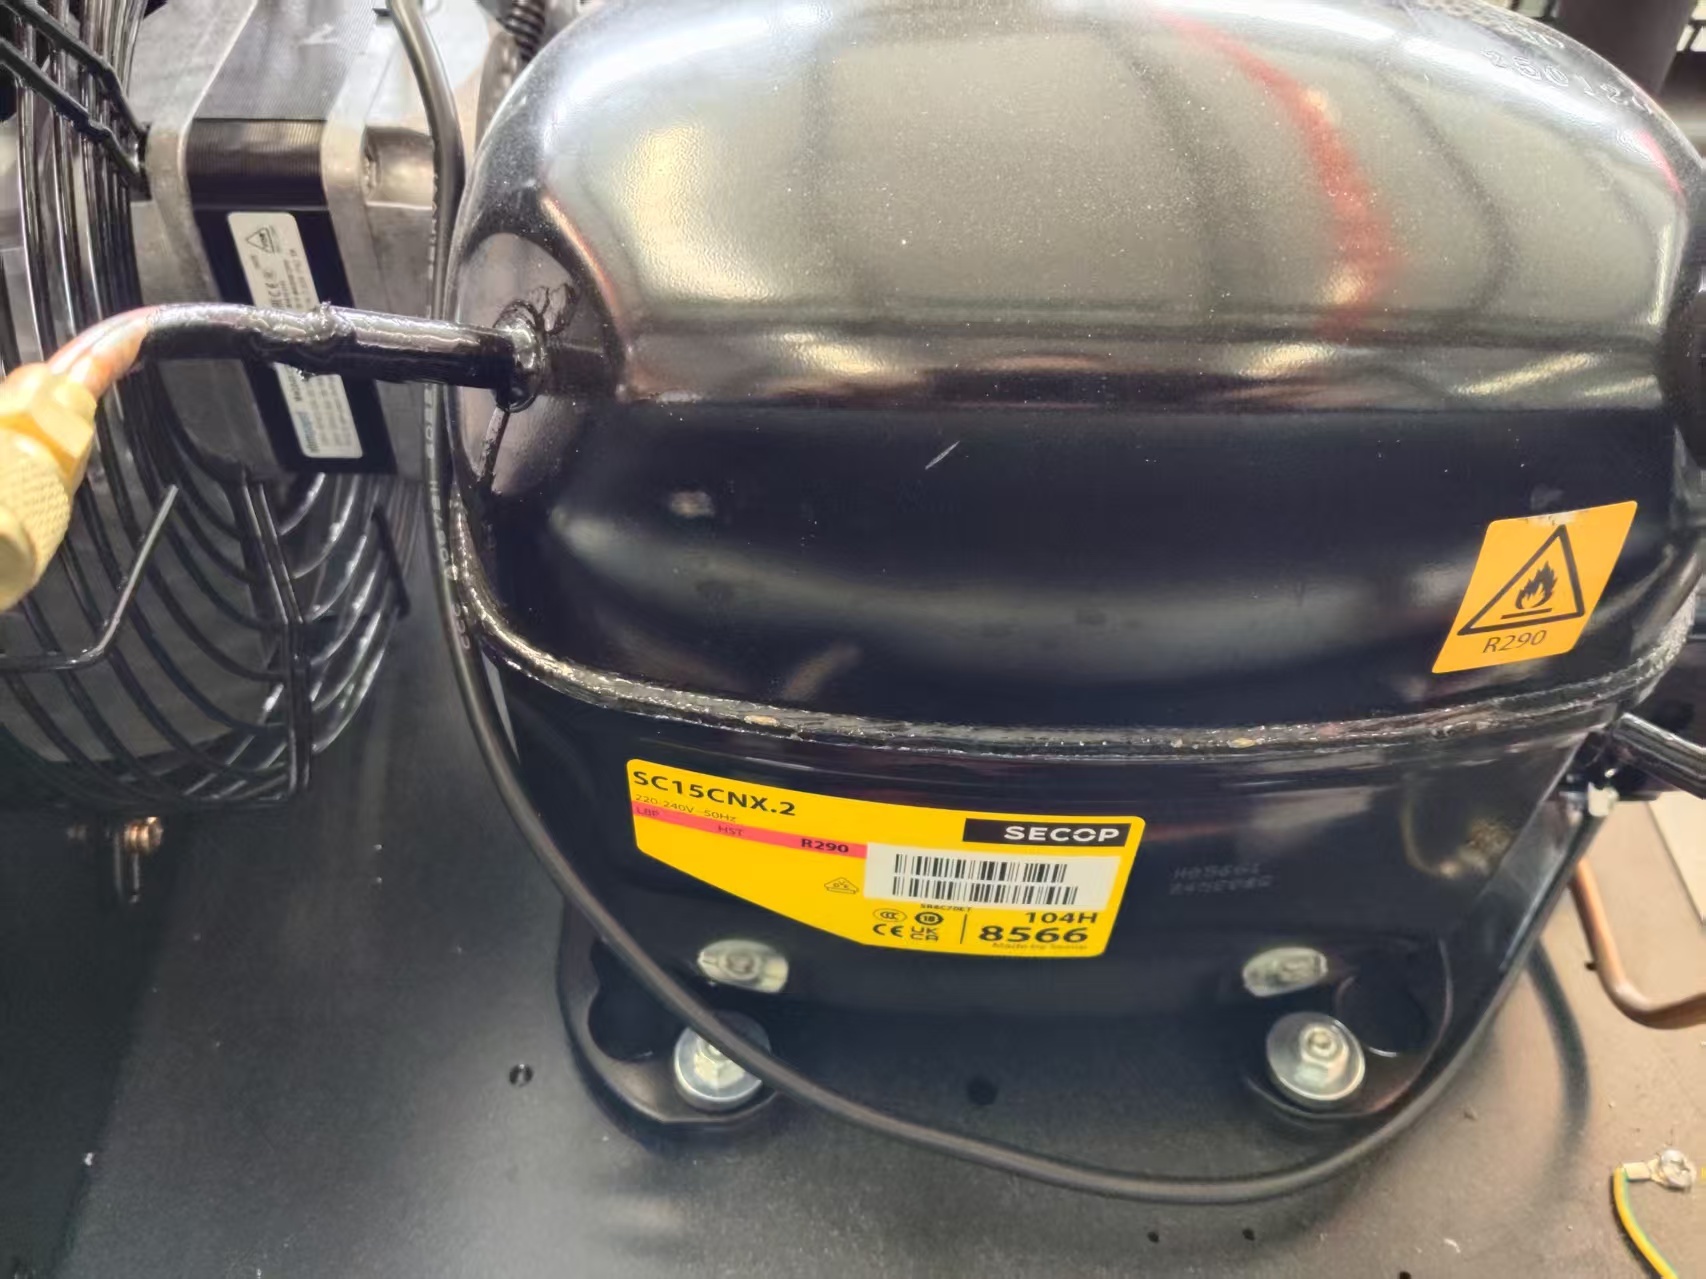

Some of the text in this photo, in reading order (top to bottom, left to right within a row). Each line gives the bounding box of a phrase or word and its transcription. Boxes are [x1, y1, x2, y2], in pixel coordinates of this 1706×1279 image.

[1482, 630, 1548, 653] R290
[633, 771, 796, 816] SC15CNX.2
[718, 825, 744, 837] HST
[801, 838, 850, 853] R290
[1003, 825, 1120, 842] SECOP
[1026, 912, 1098, 924] 104H
[872, 923, 903, 937] CE
[979, 925, 1088, 943] 8566
